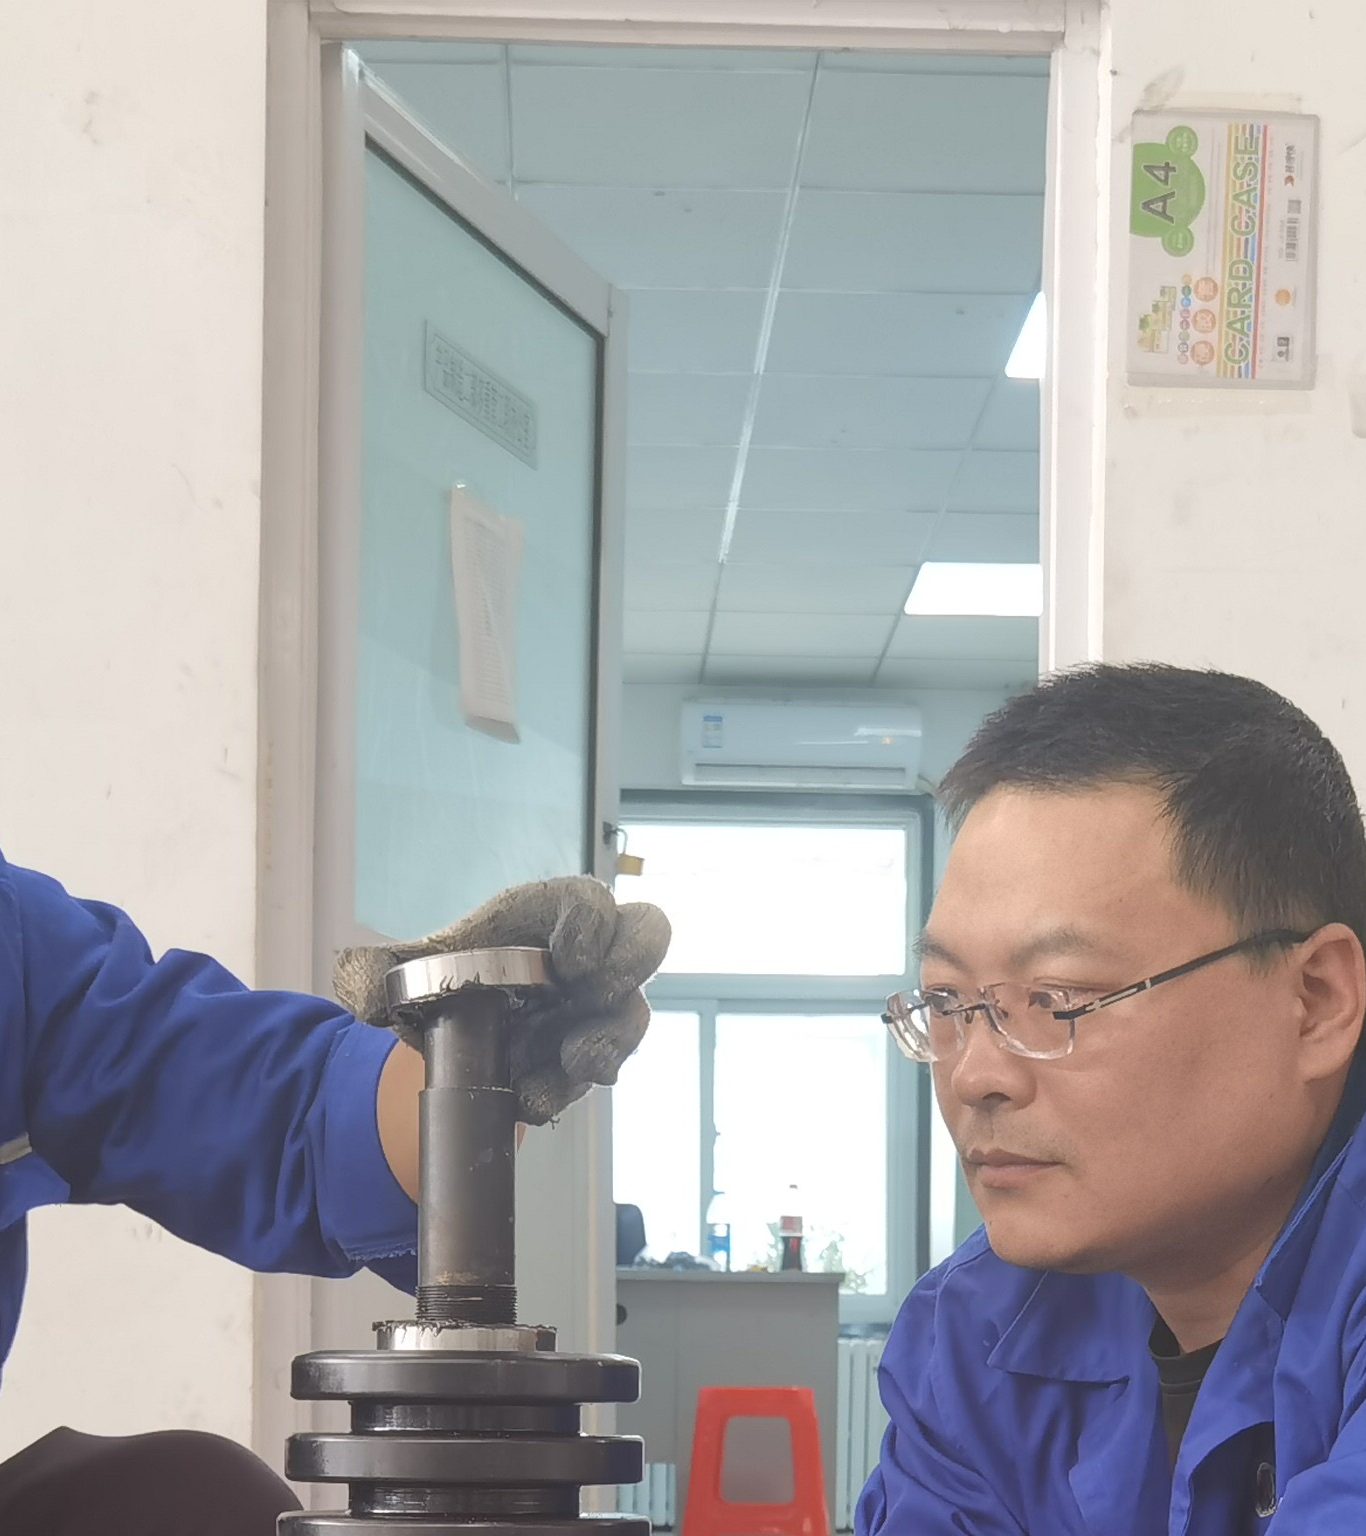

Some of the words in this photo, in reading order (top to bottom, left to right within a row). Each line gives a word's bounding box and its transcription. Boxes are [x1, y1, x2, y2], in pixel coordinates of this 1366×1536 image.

[1141, 161, 1177, 224] A4
[1230, 134, 1261, 238] CASE
[1223, 258, 1255, 366] CARD
